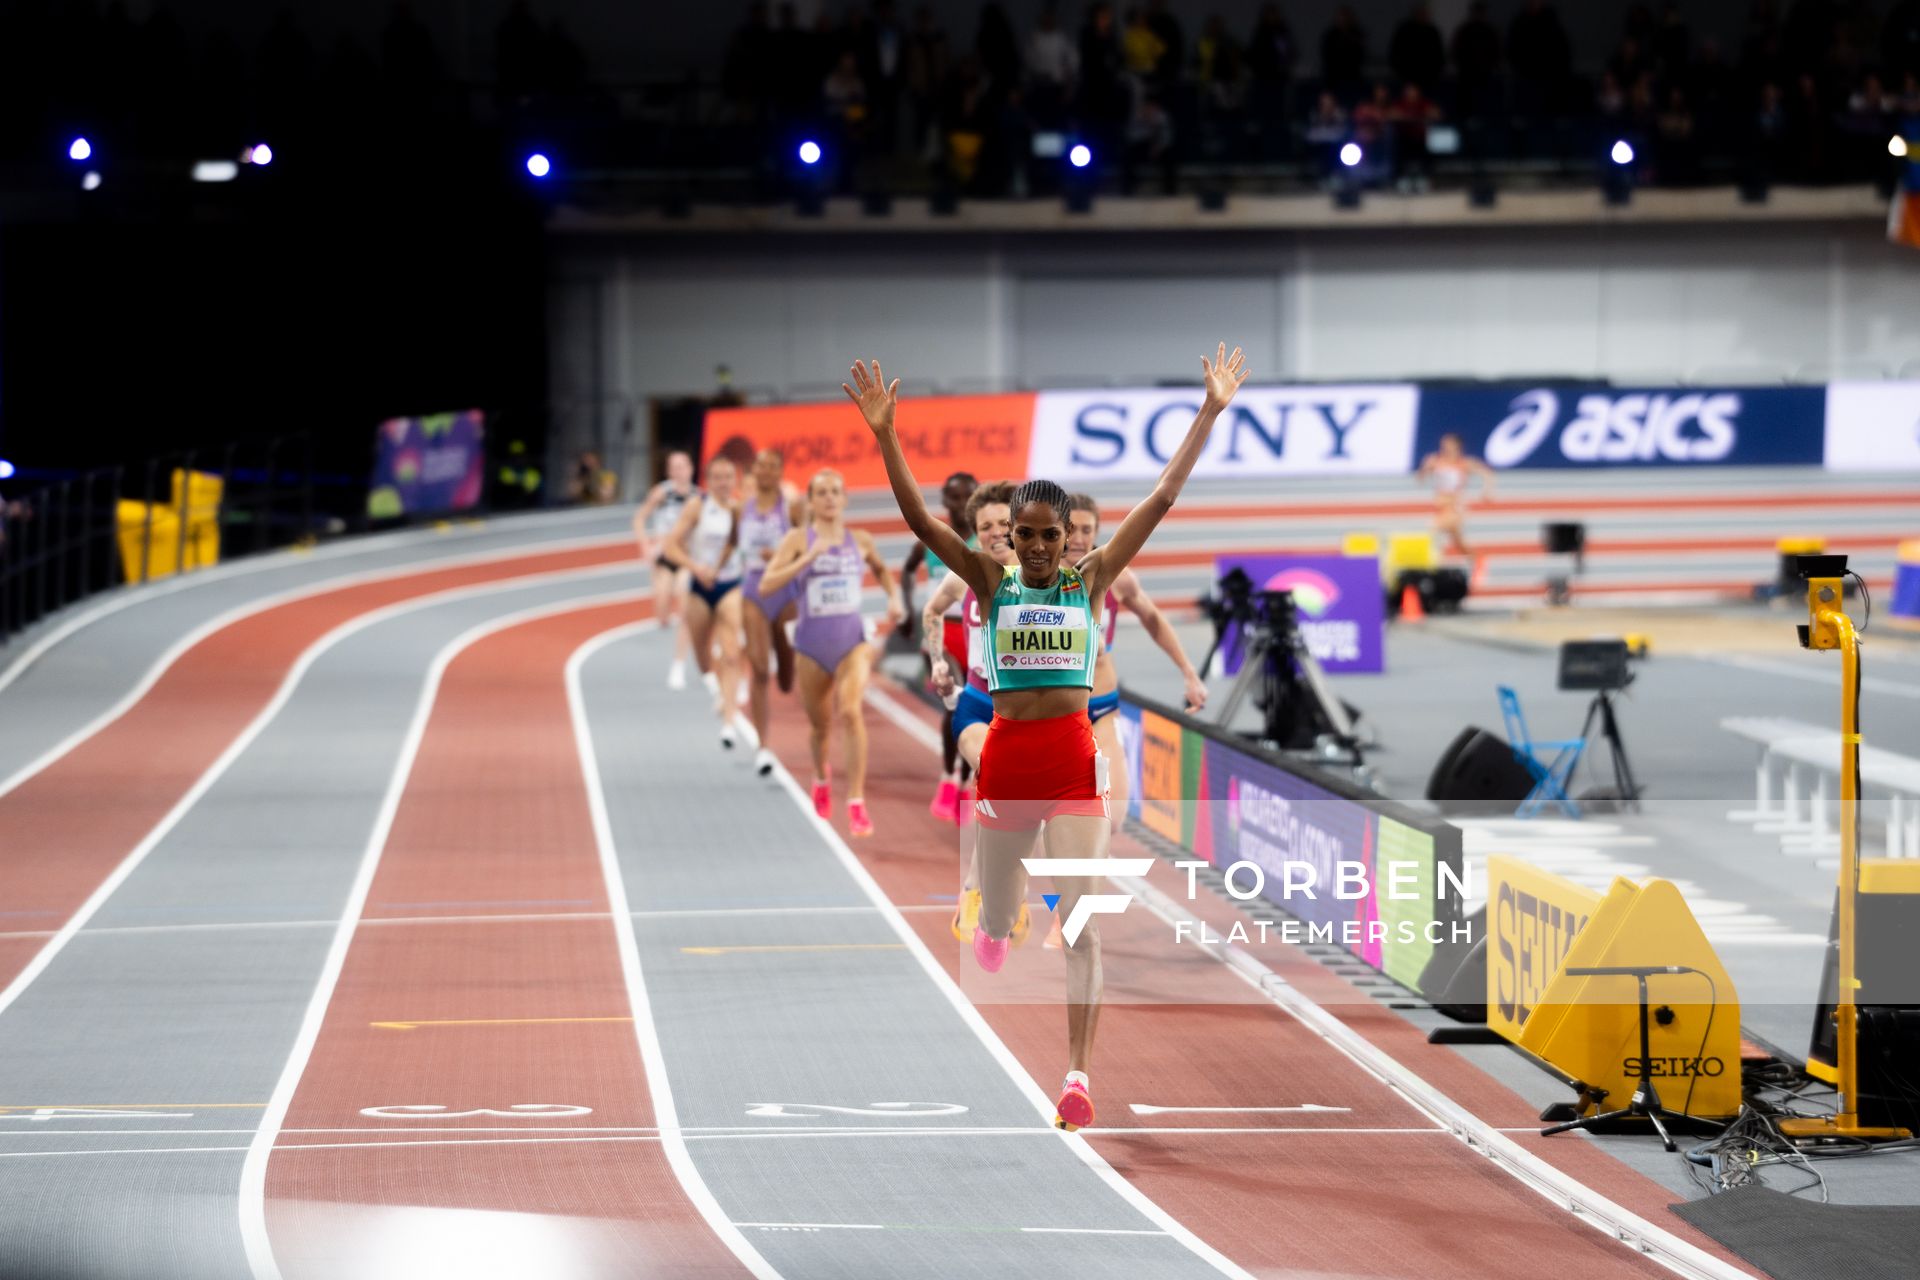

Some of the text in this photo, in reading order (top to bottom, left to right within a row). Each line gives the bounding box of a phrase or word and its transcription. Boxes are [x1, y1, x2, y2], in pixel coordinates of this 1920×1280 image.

[1071, 401, 1374, 467] SONY
[1561, 391, 1740, 461] asics
[1018, 610, 1065, 625] HI-CHEW
[1012, 631, 1072, 650] HAILU
[1623, 1057, 1724, 1077] SEIKO
[360, 1104, 593, 1118] 3
[745, 1101, 968, 1117] 2
